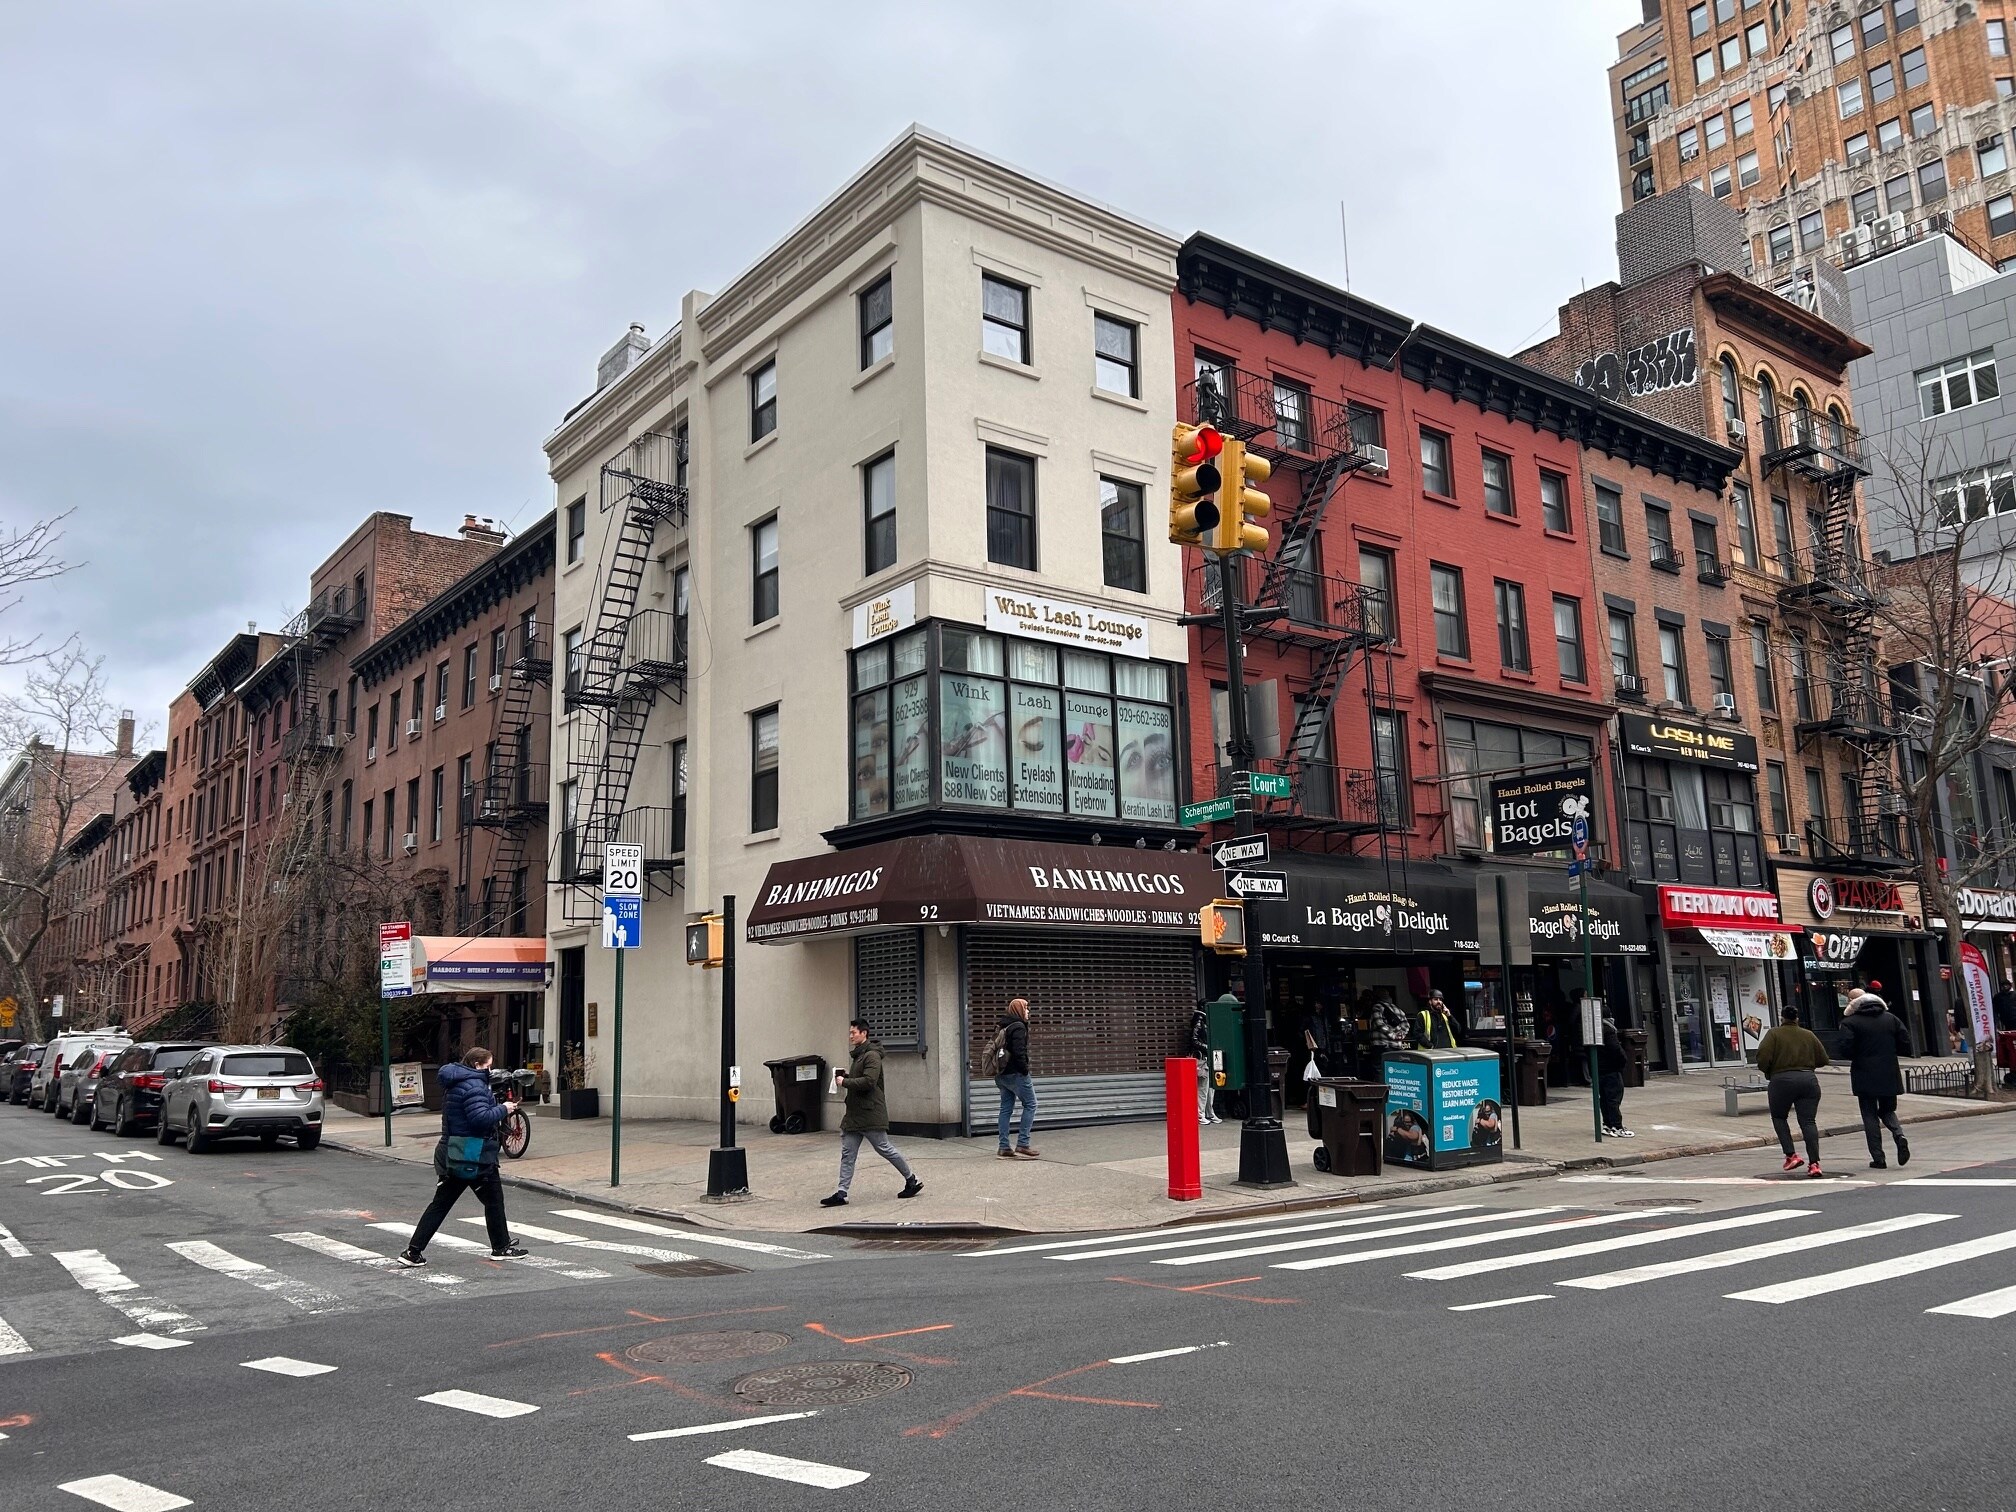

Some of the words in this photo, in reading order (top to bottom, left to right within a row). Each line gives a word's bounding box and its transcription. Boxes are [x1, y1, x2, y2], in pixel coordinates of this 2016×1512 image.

[870, 618, 898, 637] Lounge
[994, 596, 1038, 619] Wink
[1044, 606, 1082, 628] Lash
[1088, 614, 1142, 640] Lounge
[1019, 621, 1044, 632] Eyelash
[1046, 626, 1080, 640] Extensions
[904, 680, 918, 699] 929
[951, 682, 990, 701] Wink
[896, 698, 929, 722] 662-3588
[1018, 692, 1052, 710] Lash
[1068, 700, 1109, 718] Lounge
[1118, 707, 1169, 728] 929-662-3588
[1650, 723, 1704, 745] LASH
[1707, 734, 1734, 750] ME
[945, 761, 969, 779] New
[972, 764, 1005, 782] Clients
[1021, 762, 1056, 785] Eyelash
[944, 780, 962, 799] $88
[964, 782, 989, 800] New
[990, 786, 1007, 803] Set
[1068, 770, 1114, 796] Microblading
[1254, 776, 1277, 793] Court
[1279, 777, 1285, 787] St
[1498, 788, 1521, 798] Hand
[1524, 783, 1552, 794] Rolled
[1555, 778, 1586, 790] Bagels
[1014, 784, 1063, 806] Extensions
[1074, 791, 1107, 813] Eyebrow
[1122, 801, 1145, 816] Keratin
[1147, 804, 1163, 819] Lash
[1164, 806, 1175, 820] Lift
[1185, 800, 1231, 818] Schermerhorn
[1499, 800, 1538, 822] Hot
[1500, 818, 1572, 845] Bagels
[609, 849, 639, 857] SPEED
[1221, 848, 1237, 860] ONE
[1240, 844, 1260, 858] WAY
[610, 870, 638, 889] 20
[765, 867, 883, 906] BANHMIGOS
[1029, 866, 1185, 895] BANHMIGOS
[1236, 880, 1255, 891] ONE
[1260, 880, 1278, 891] WAY
[1348, 893, 1367, 904] Hand
[1369, 892, 1390, 902] Rolled
[1667, 891, 1744, 916] TERIYAKI
[1744, 897, 1779, 918] ONE
[1833, 878, 1904, 911] PANDA
[920, 906, 938, 919] 92
[986, 904, 1046, 920] VIETNAMESE
[1152, 912, 1183, 924] DRINKS
[1544, 904, 1560, 914] Hand
[1560, 903, 1578, 912] Rolled
[747, 926, 754, 939] 92
[830, 912, 848, 927] DRINKS
[1306, 906, 1327, 926] La
[1332, 908, 1375, 932] Bagel
[1398, 910, 1449, 935] Delight
[1529, 918, 1563, 938] Bagel
[1580, 920, 1620, 940] elight
[1262, 933, 1270, 942] 90
[1272, 934, 1290, 943] Court
[1291, 934, 1300, 943] St.
[1972, 967, 1986, 1011] TERIYAKI
[1981, 1014, 1990, 1035] ONE
[1442, 1080, 1461, 1088] REDUCE
[1442, 1090, 1464, 1098] RESTORE
[1442, 1100, 1460, 1108] LEARN
[26, 1170, 176, 1195] 20
